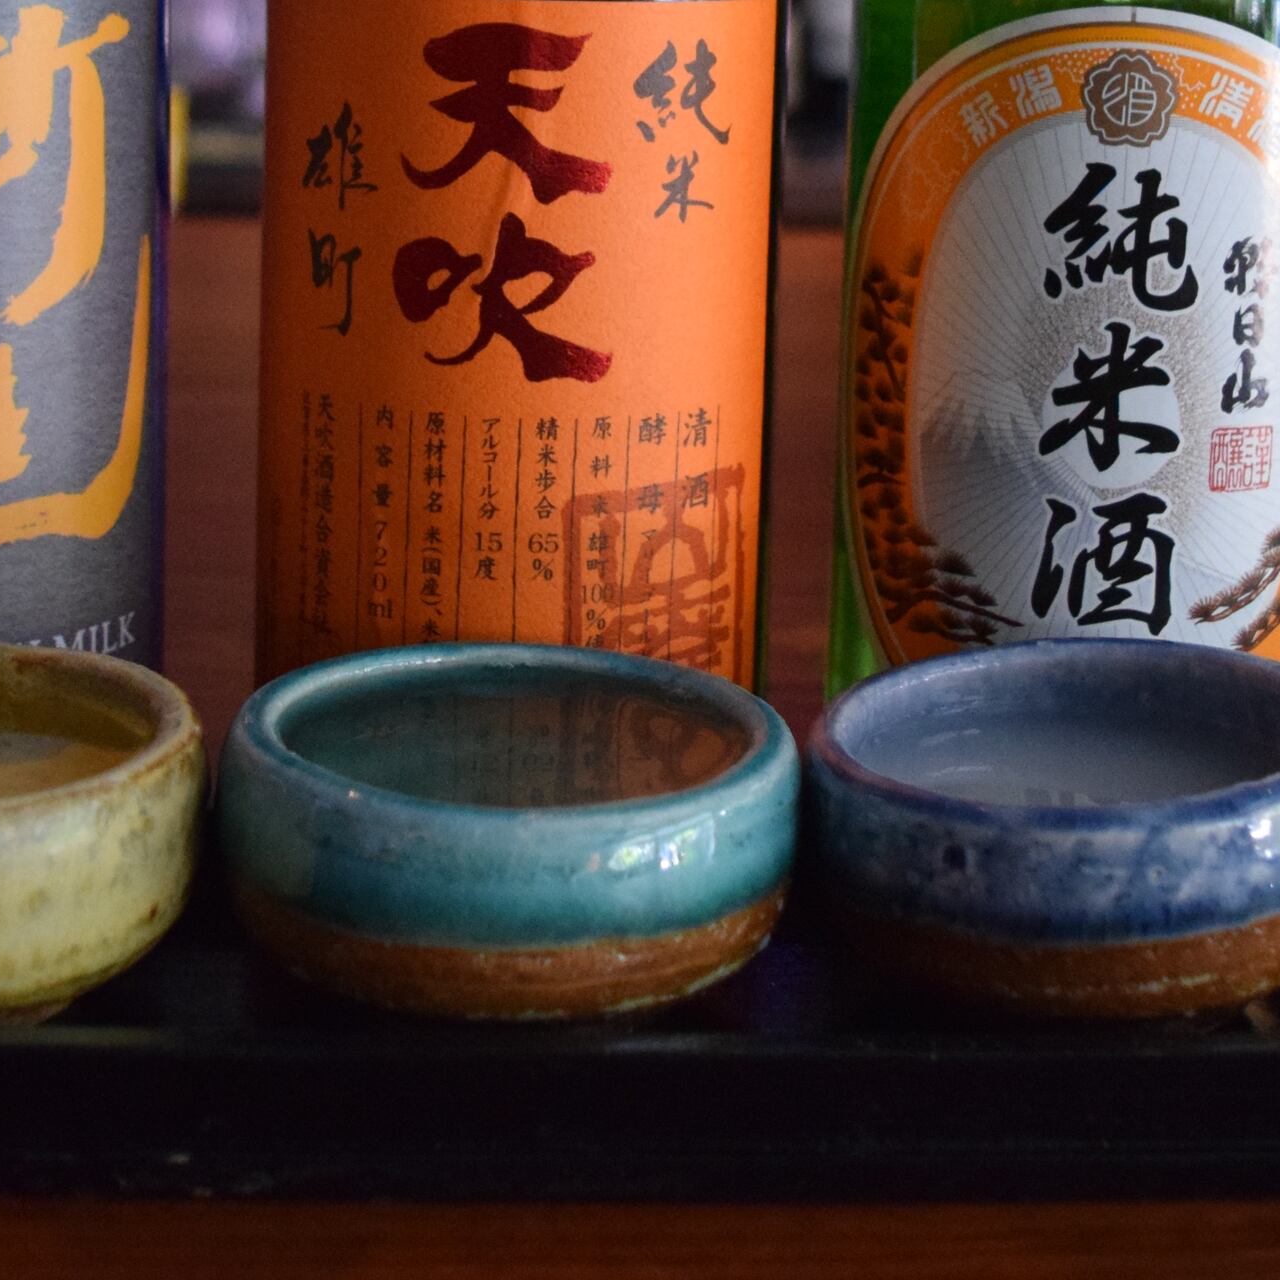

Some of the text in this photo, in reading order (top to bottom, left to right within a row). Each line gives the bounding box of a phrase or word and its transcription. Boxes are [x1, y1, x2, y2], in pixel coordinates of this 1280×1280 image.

[393, 23, 614, 383] 天吹
[632, 38, 733, 224] 純米
[300, 103, 379, 337] 雄町
[372, 404, 394, 508] 内容量
[423, 411, 446, 514] 原材料名
[591, 416, 613, 516] 原料米
[637, 412, 668, 516] 酵母
[679, 407, 712, 509] 清酒
[1030, 163, 1199, 635] 純米酒
[474, 418, 503, 581] アルコール分 15度
[527, 417, 560, 582] 精米歩合 65%
